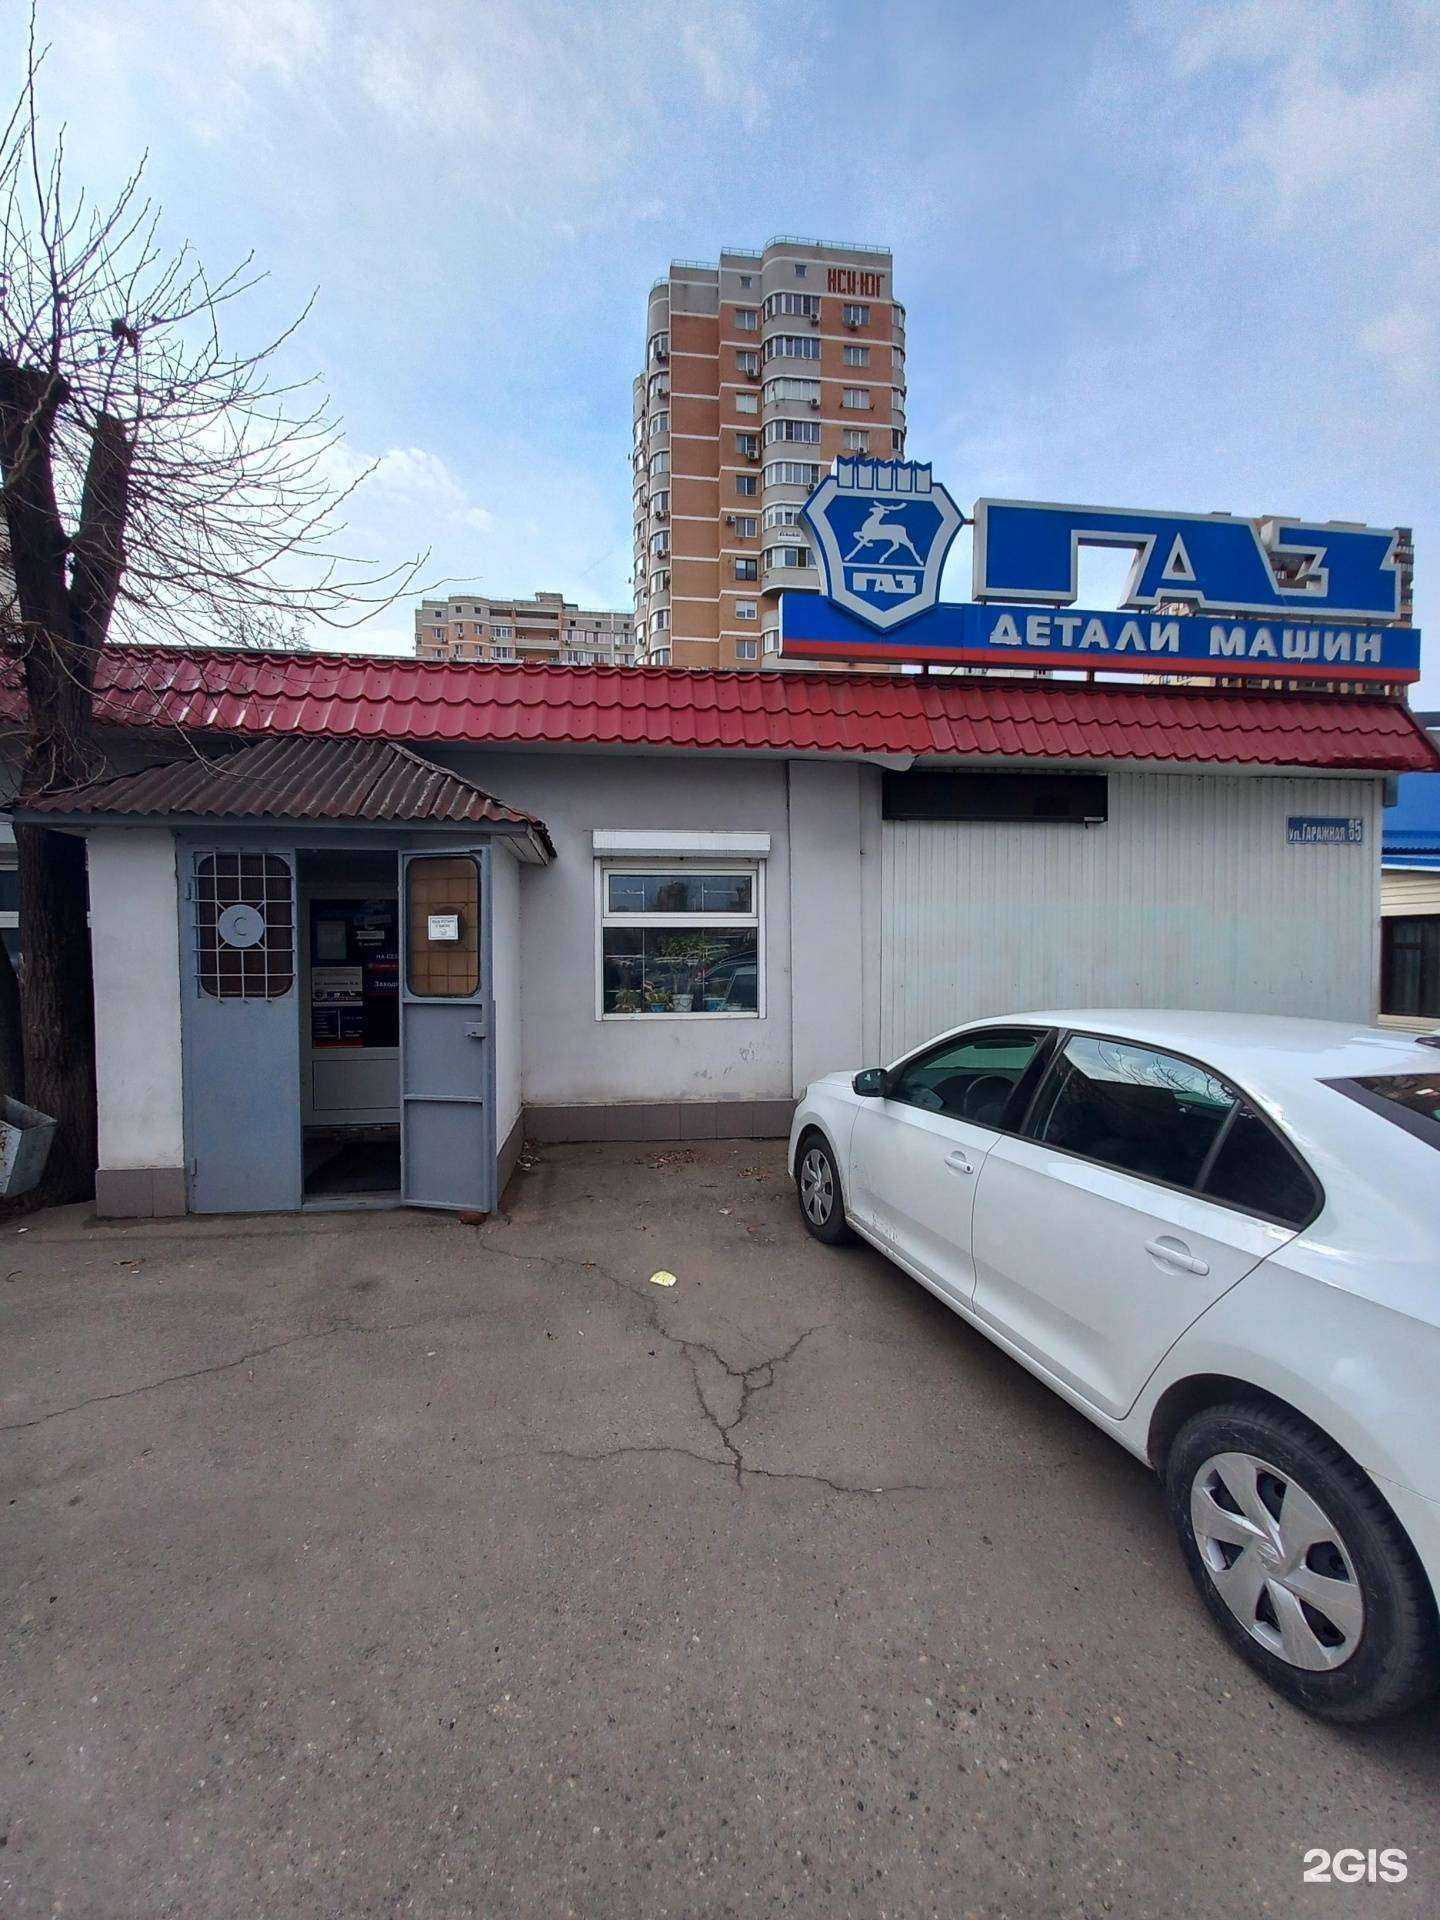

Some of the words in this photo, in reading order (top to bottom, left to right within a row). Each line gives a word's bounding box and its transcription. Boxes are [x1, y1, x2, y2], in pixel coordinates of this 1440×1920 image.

[853, 572, 916, 594] ГАЗ
[973, 497, 1400, 624] ГАЗ
[989, 614, 1180, 653] ДЕТАЛИ
[1209, 624, 1383, 664] МАШИН
